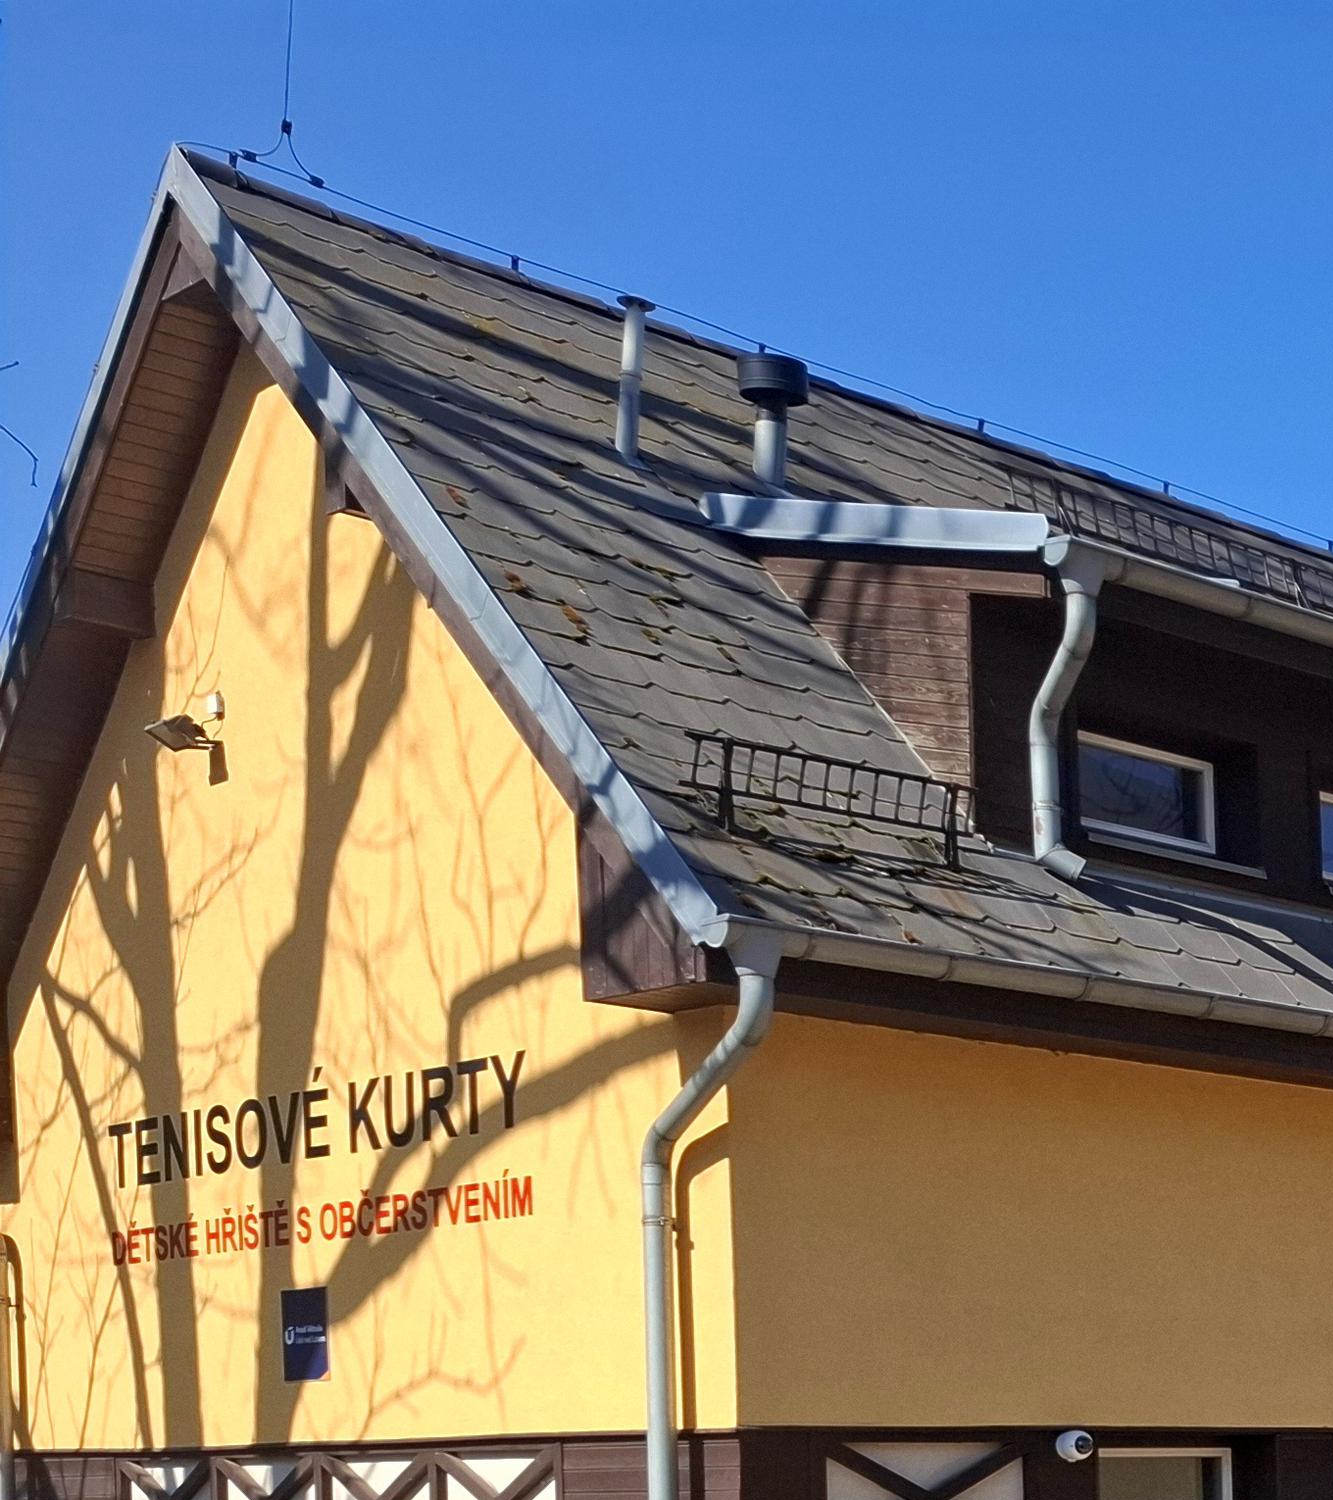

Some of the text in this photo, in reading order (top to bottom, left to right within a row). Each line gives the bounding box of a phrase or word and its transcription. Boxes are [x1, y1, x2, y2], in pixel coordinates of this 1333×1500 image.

[108, 1049, 527, 1188] TENISOVÉ KURTY
[111, 1169, 535, 1267] DĚTSKÉ HŘIŠTĚ S OBČERSTVENÍM
